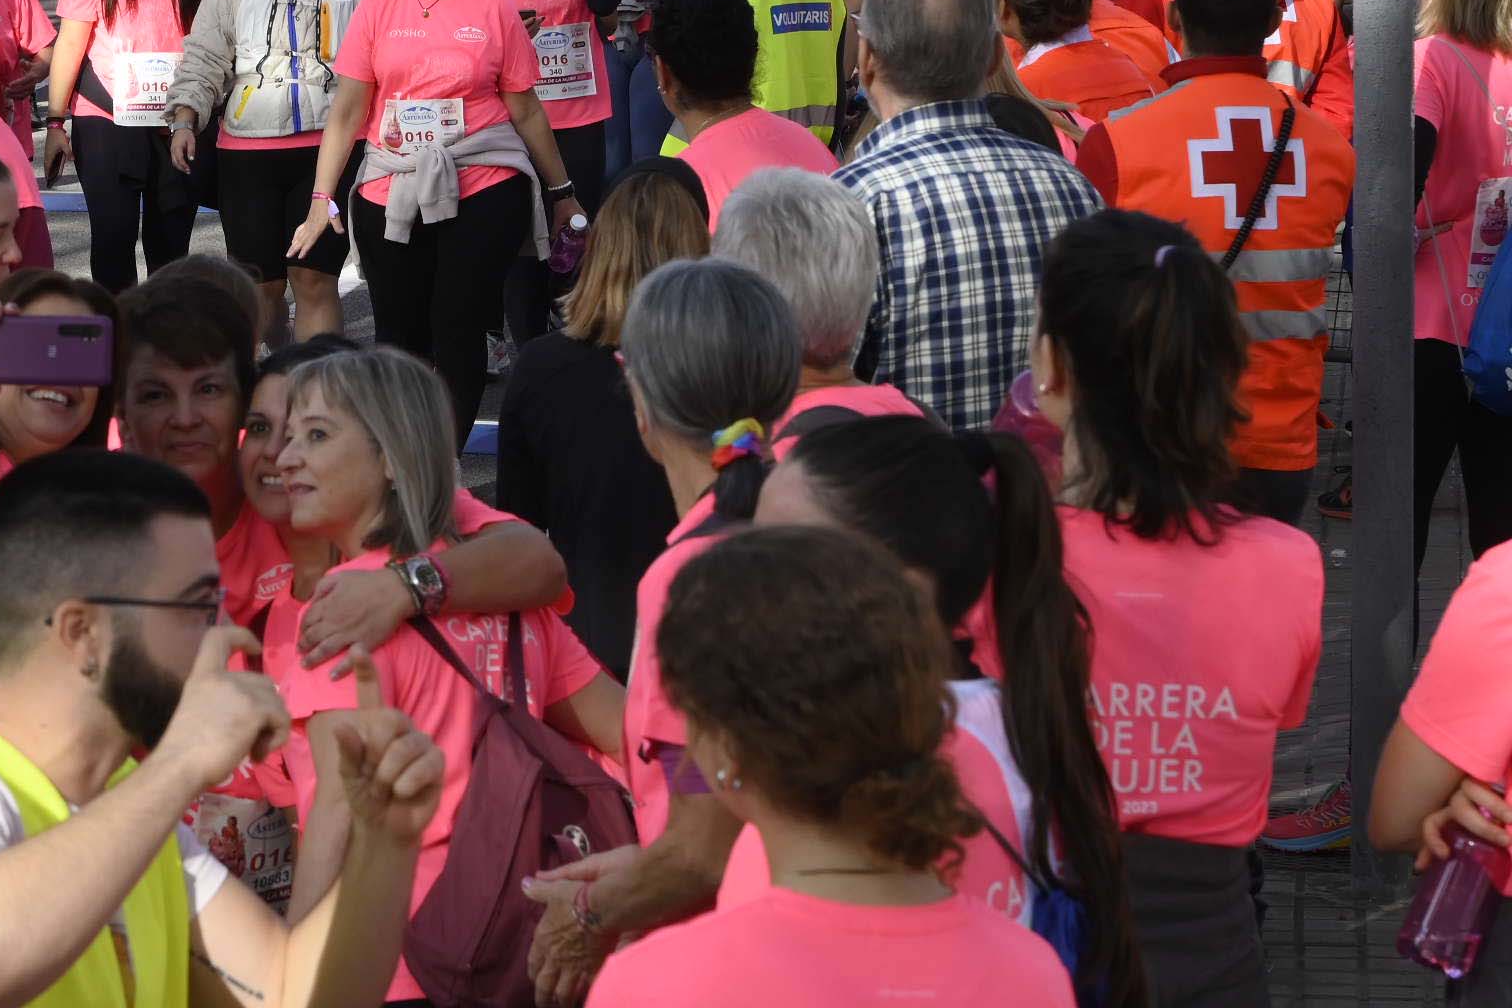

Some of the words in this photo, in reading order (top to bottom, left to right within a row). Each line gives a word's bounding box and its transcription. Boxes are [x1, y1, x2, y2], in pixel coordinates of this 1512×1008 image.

[390, 29, 426, 39] OYSHO
[541, 53, 569, 67] 016
[549, 68, 563, 76] 340
[142, 81, 168, 92] 016
[403, 113, 435, 121] ASTURIANA
[405, 130, 434, 143] 016
[1150, 724, 1199, 756] LA
[1122, 800, 1159, 815] 2023
